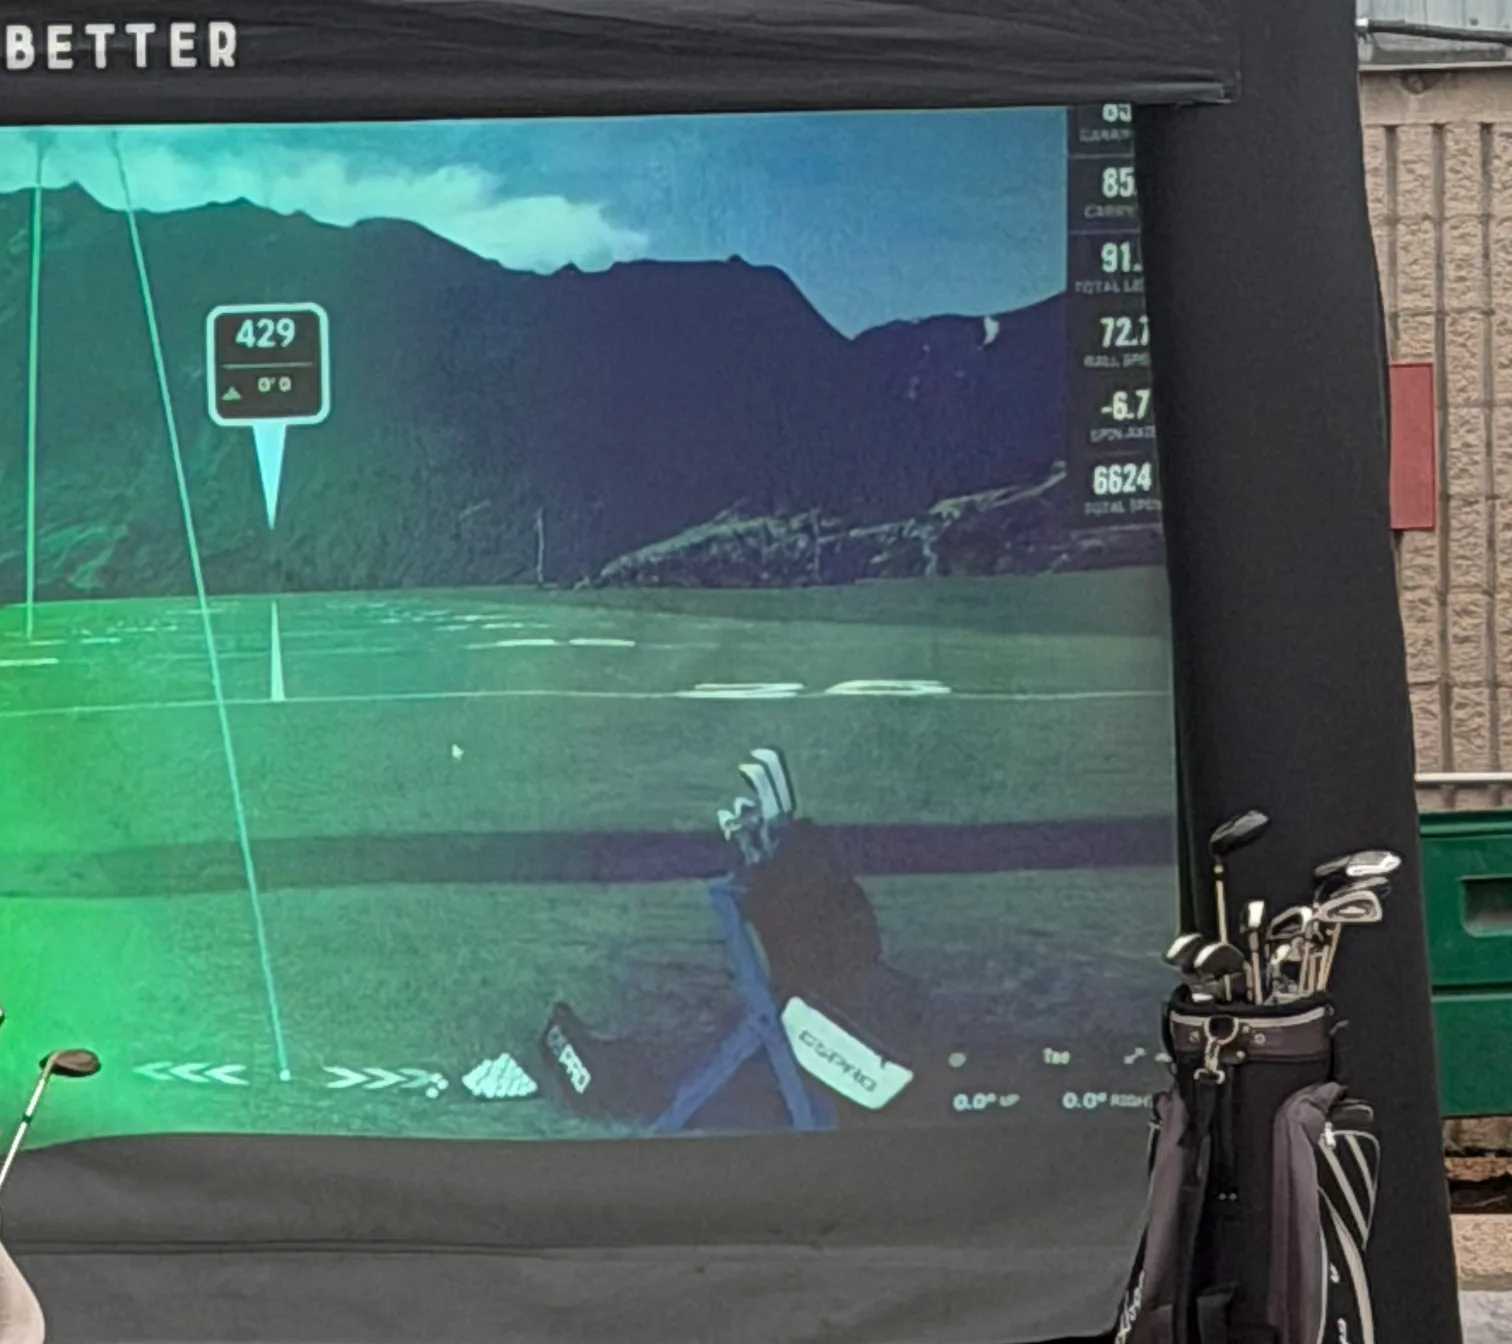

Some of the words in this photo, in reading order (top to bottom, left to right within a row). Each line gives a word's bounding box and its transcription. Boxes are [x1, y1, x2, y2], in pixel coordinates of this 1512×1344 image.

[5, 20, 237, 71] BETTER
[236, 317, 295, 348] 429
[1101, 389, 1152, 421] -6.7
[1093, 462, 1152, 495] 6624
